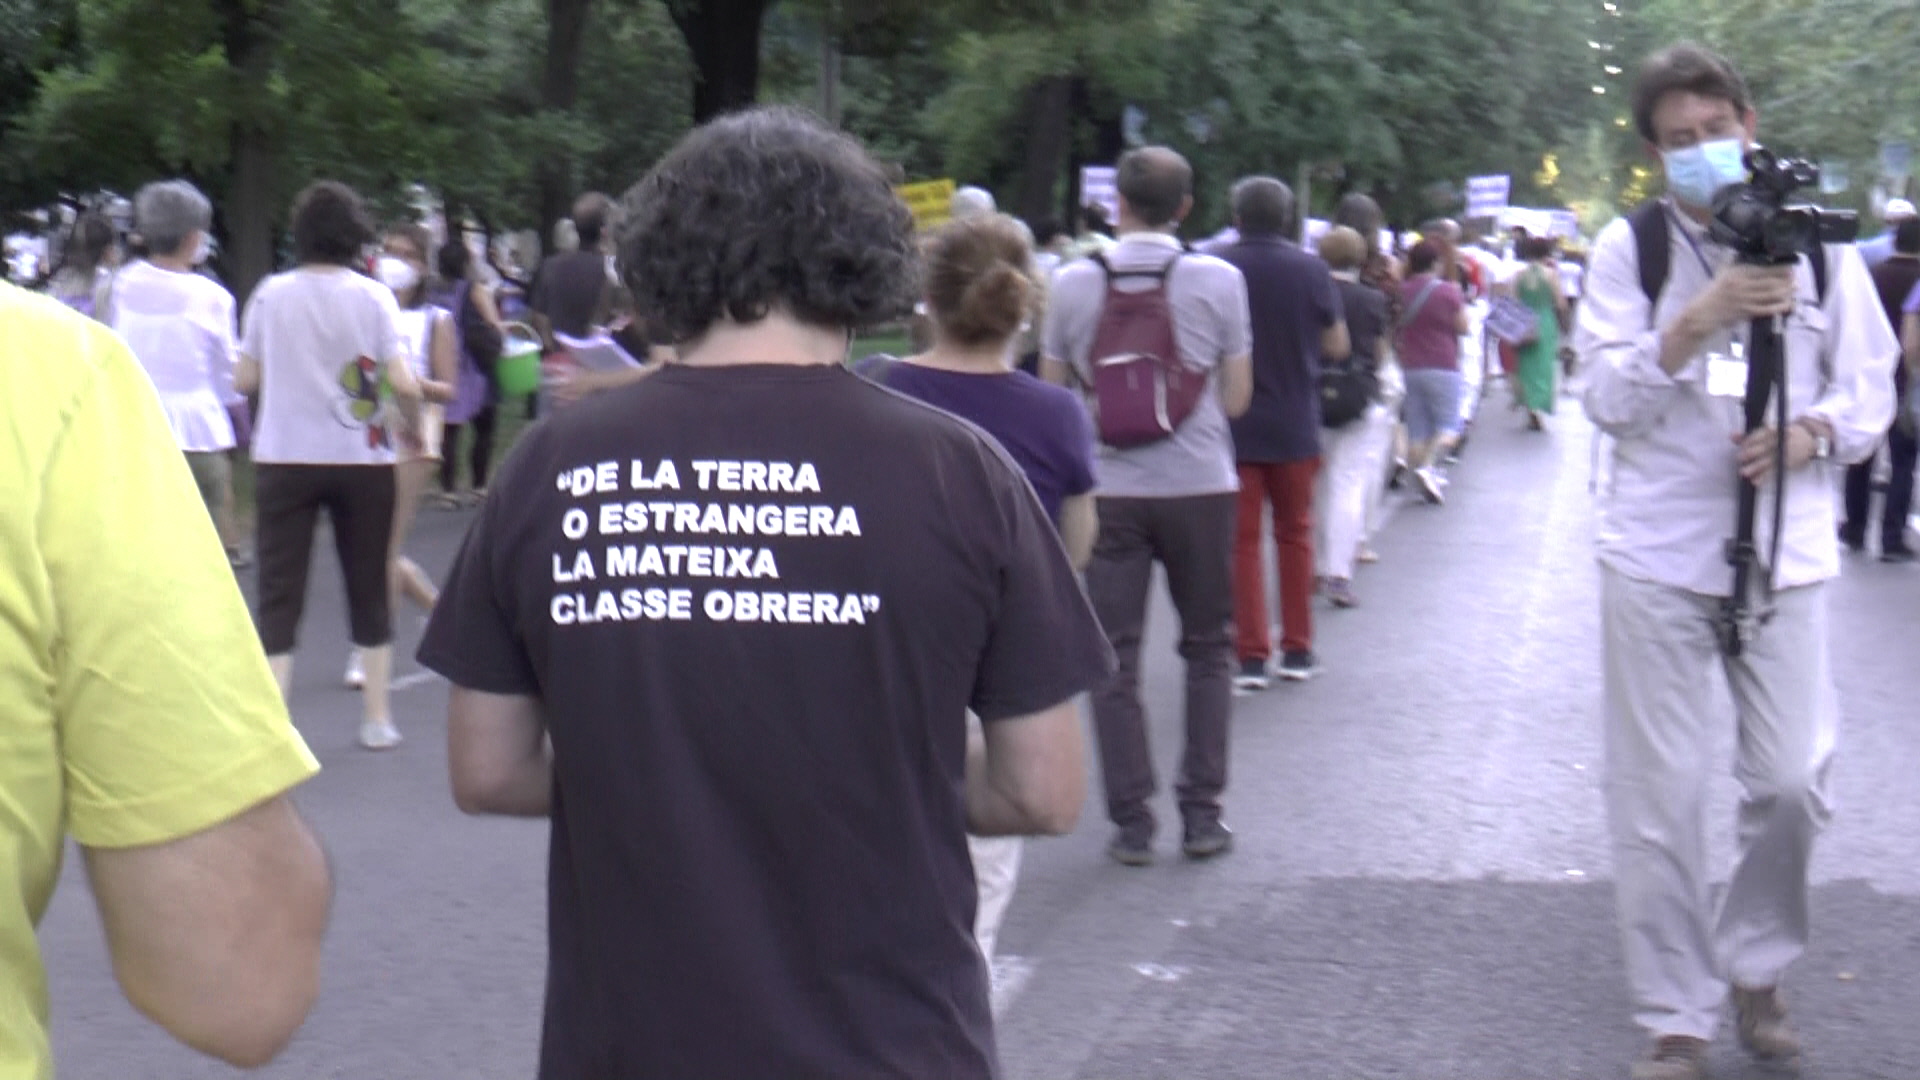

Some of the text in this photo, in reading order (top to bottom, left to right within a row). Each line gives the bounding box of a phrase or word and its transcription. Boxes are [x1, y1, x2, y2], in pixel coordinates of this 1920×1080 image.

[630, 459, 681, 490] LA
[691, 460, 821, 493] TERRA
[562, 501, 862, 540] O ESTRANGERA
[553, 544, 780, 583] LA MATEIXA
[550, 587, 693, 625] CLASSE
